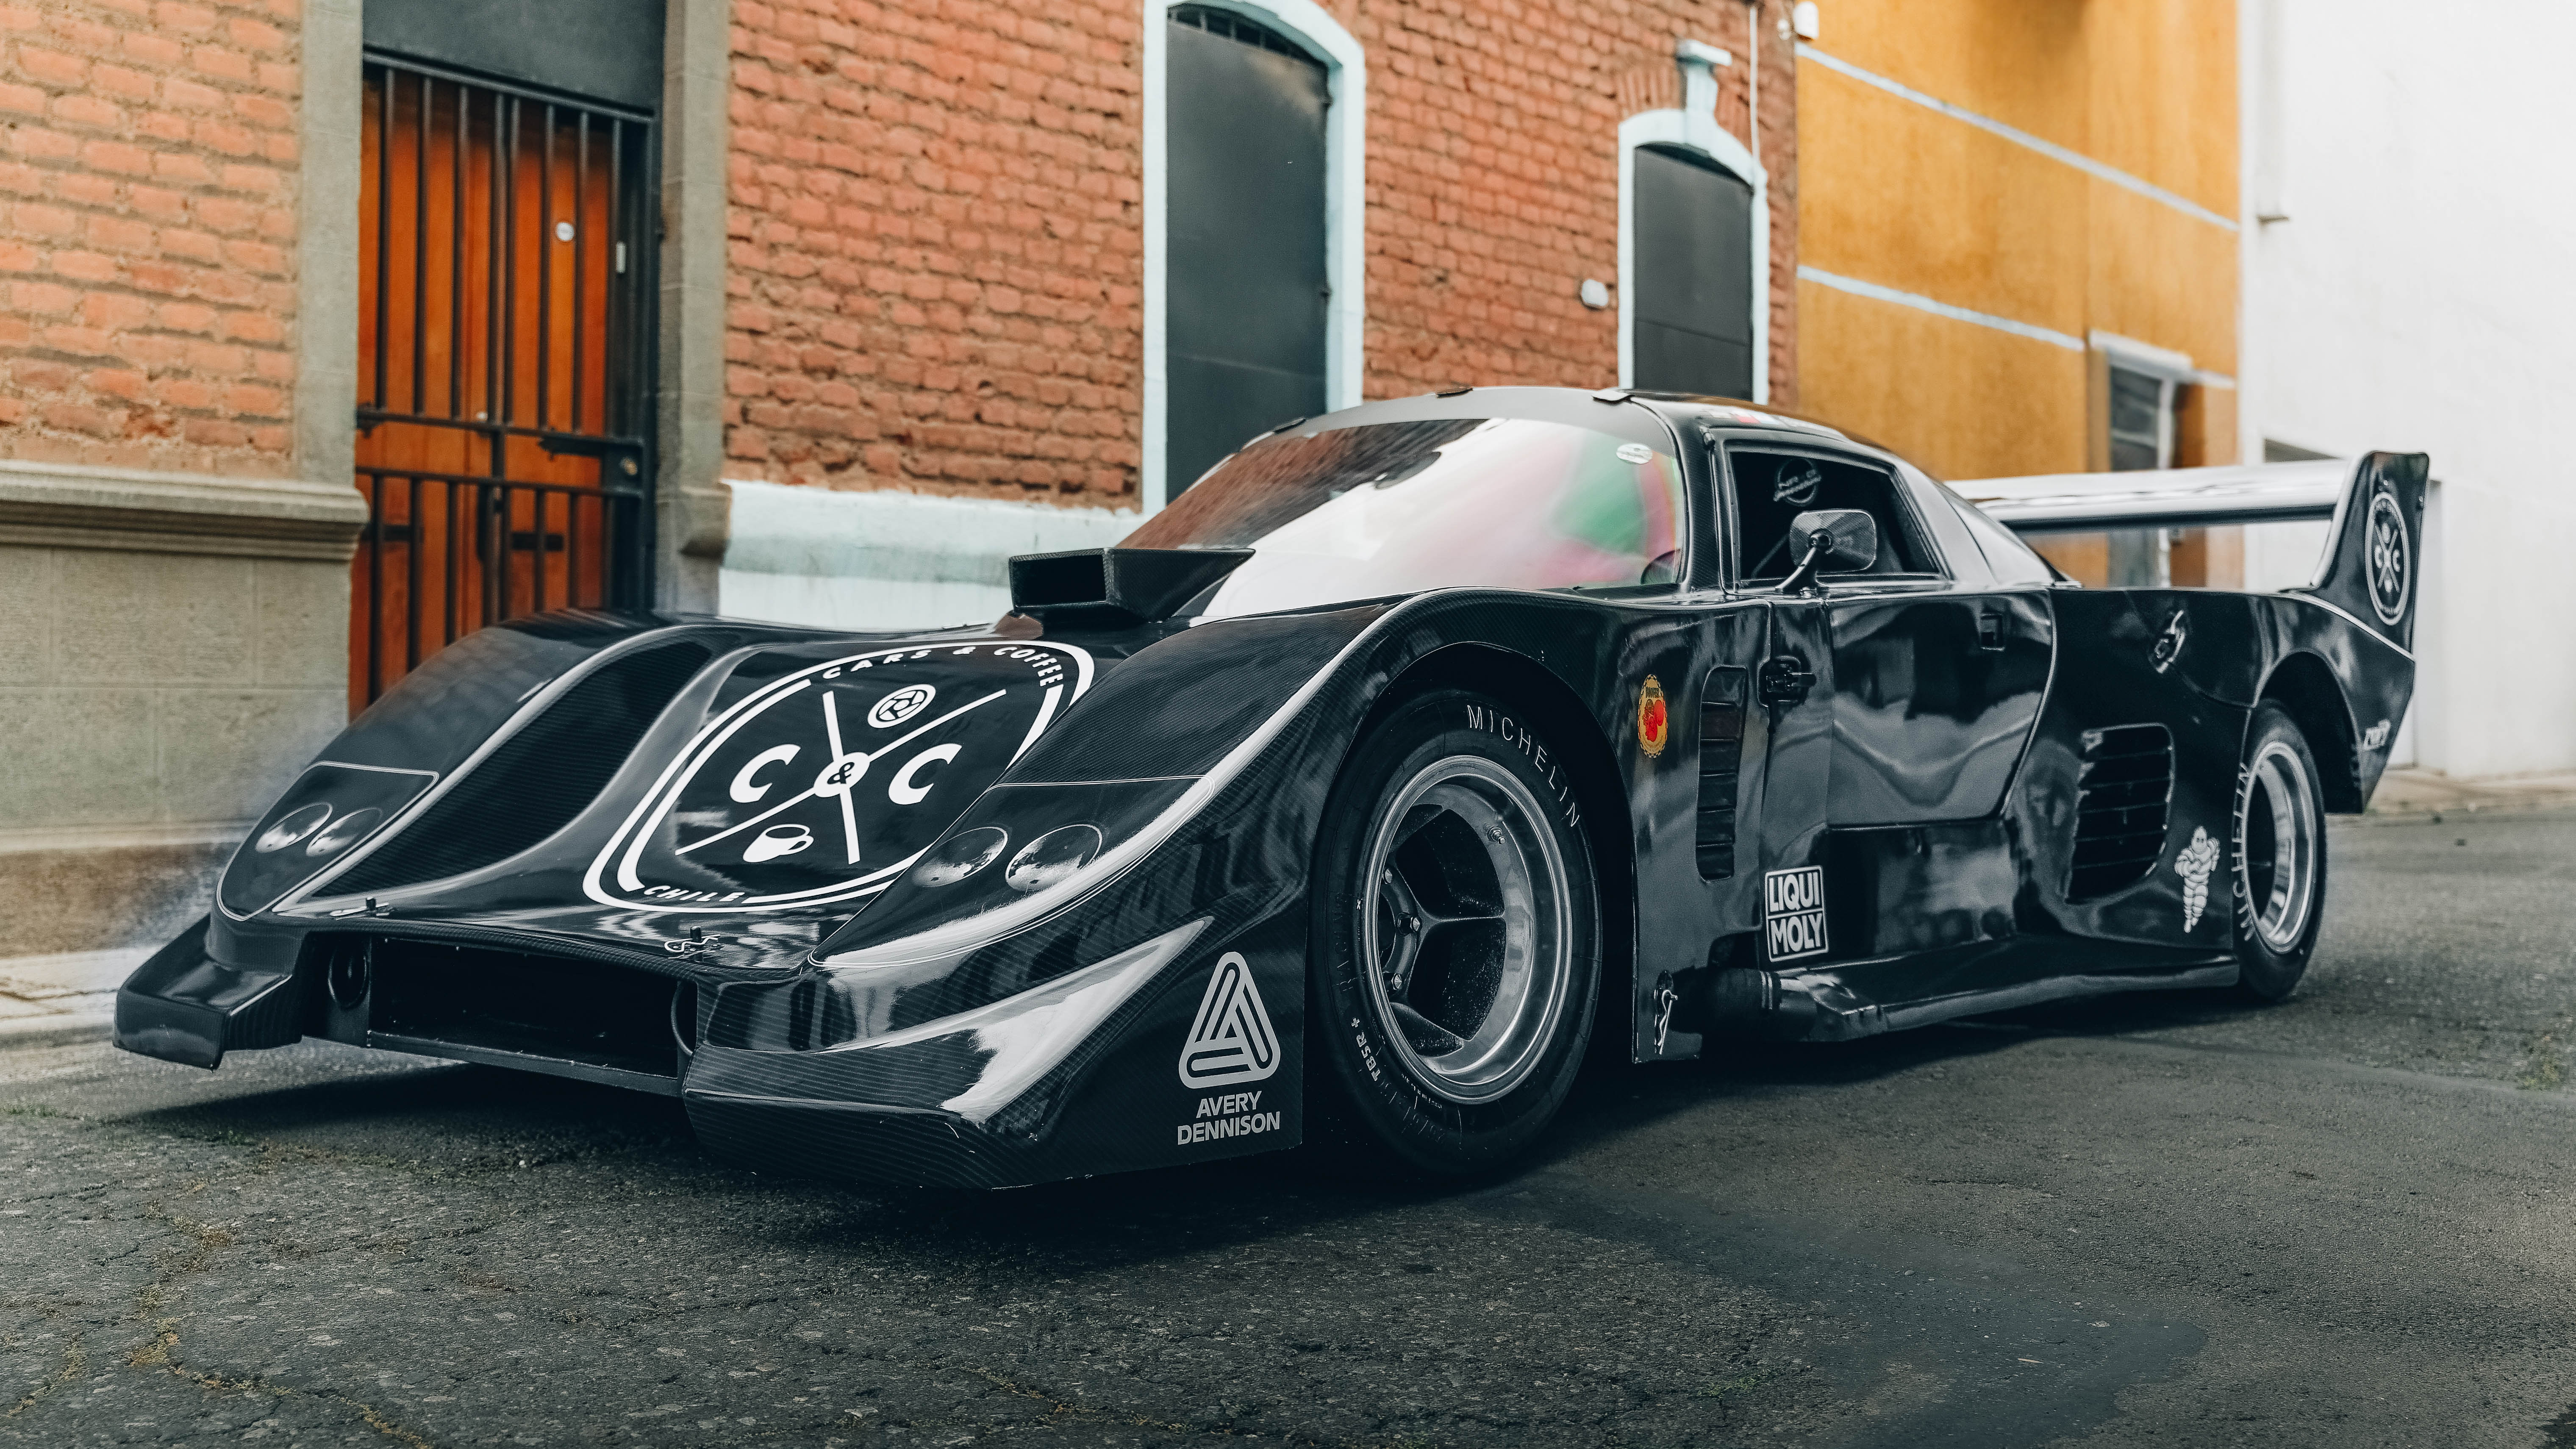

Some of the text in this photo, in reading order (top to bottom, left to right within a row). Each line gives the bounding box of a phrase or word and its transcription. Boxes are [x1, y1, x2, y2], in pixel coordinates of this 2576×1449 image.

[822, 646, 1063, 687] CARS & COFFEE
[730, 744, 962, 805] C & C
[1466, 704, 1580, 828] MICHELIN
[644, 885, 745, 902] CHILE
[1769, 872, 1820, 913] LIQUI
[1770, 913, 1822, 955] MOLY
[1196, 1091, 1262, 1118] AVERY
[1177, 1111, 1280, 1145] DENNISON
